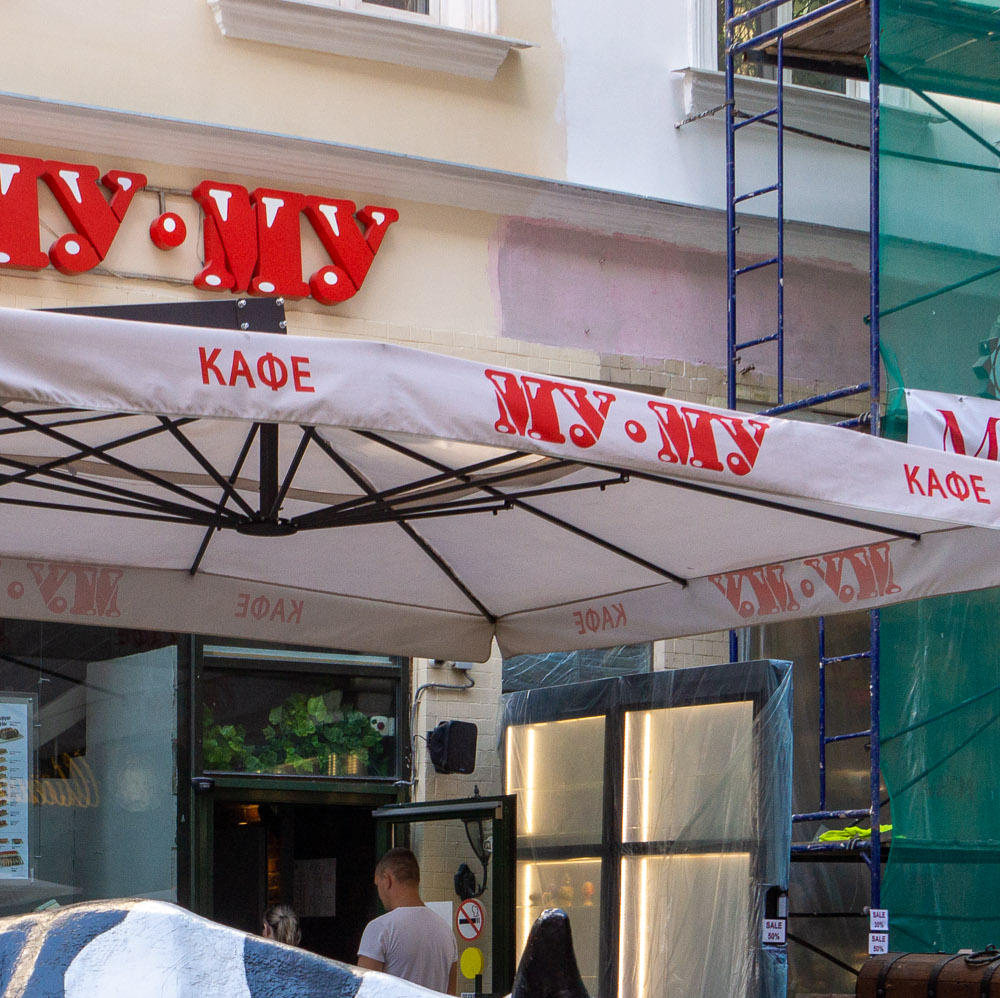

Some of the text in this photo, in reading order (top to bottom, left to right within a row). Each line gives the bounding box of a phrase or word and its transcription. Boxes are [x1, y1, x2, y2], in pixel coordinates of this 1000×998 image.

[199, 346, 316, 393] КАФЕ
[904, 463, 991, 505] КАФЕ
[765, 921, 783, 930] SALE
[872, 935, 886, 943] SALE
